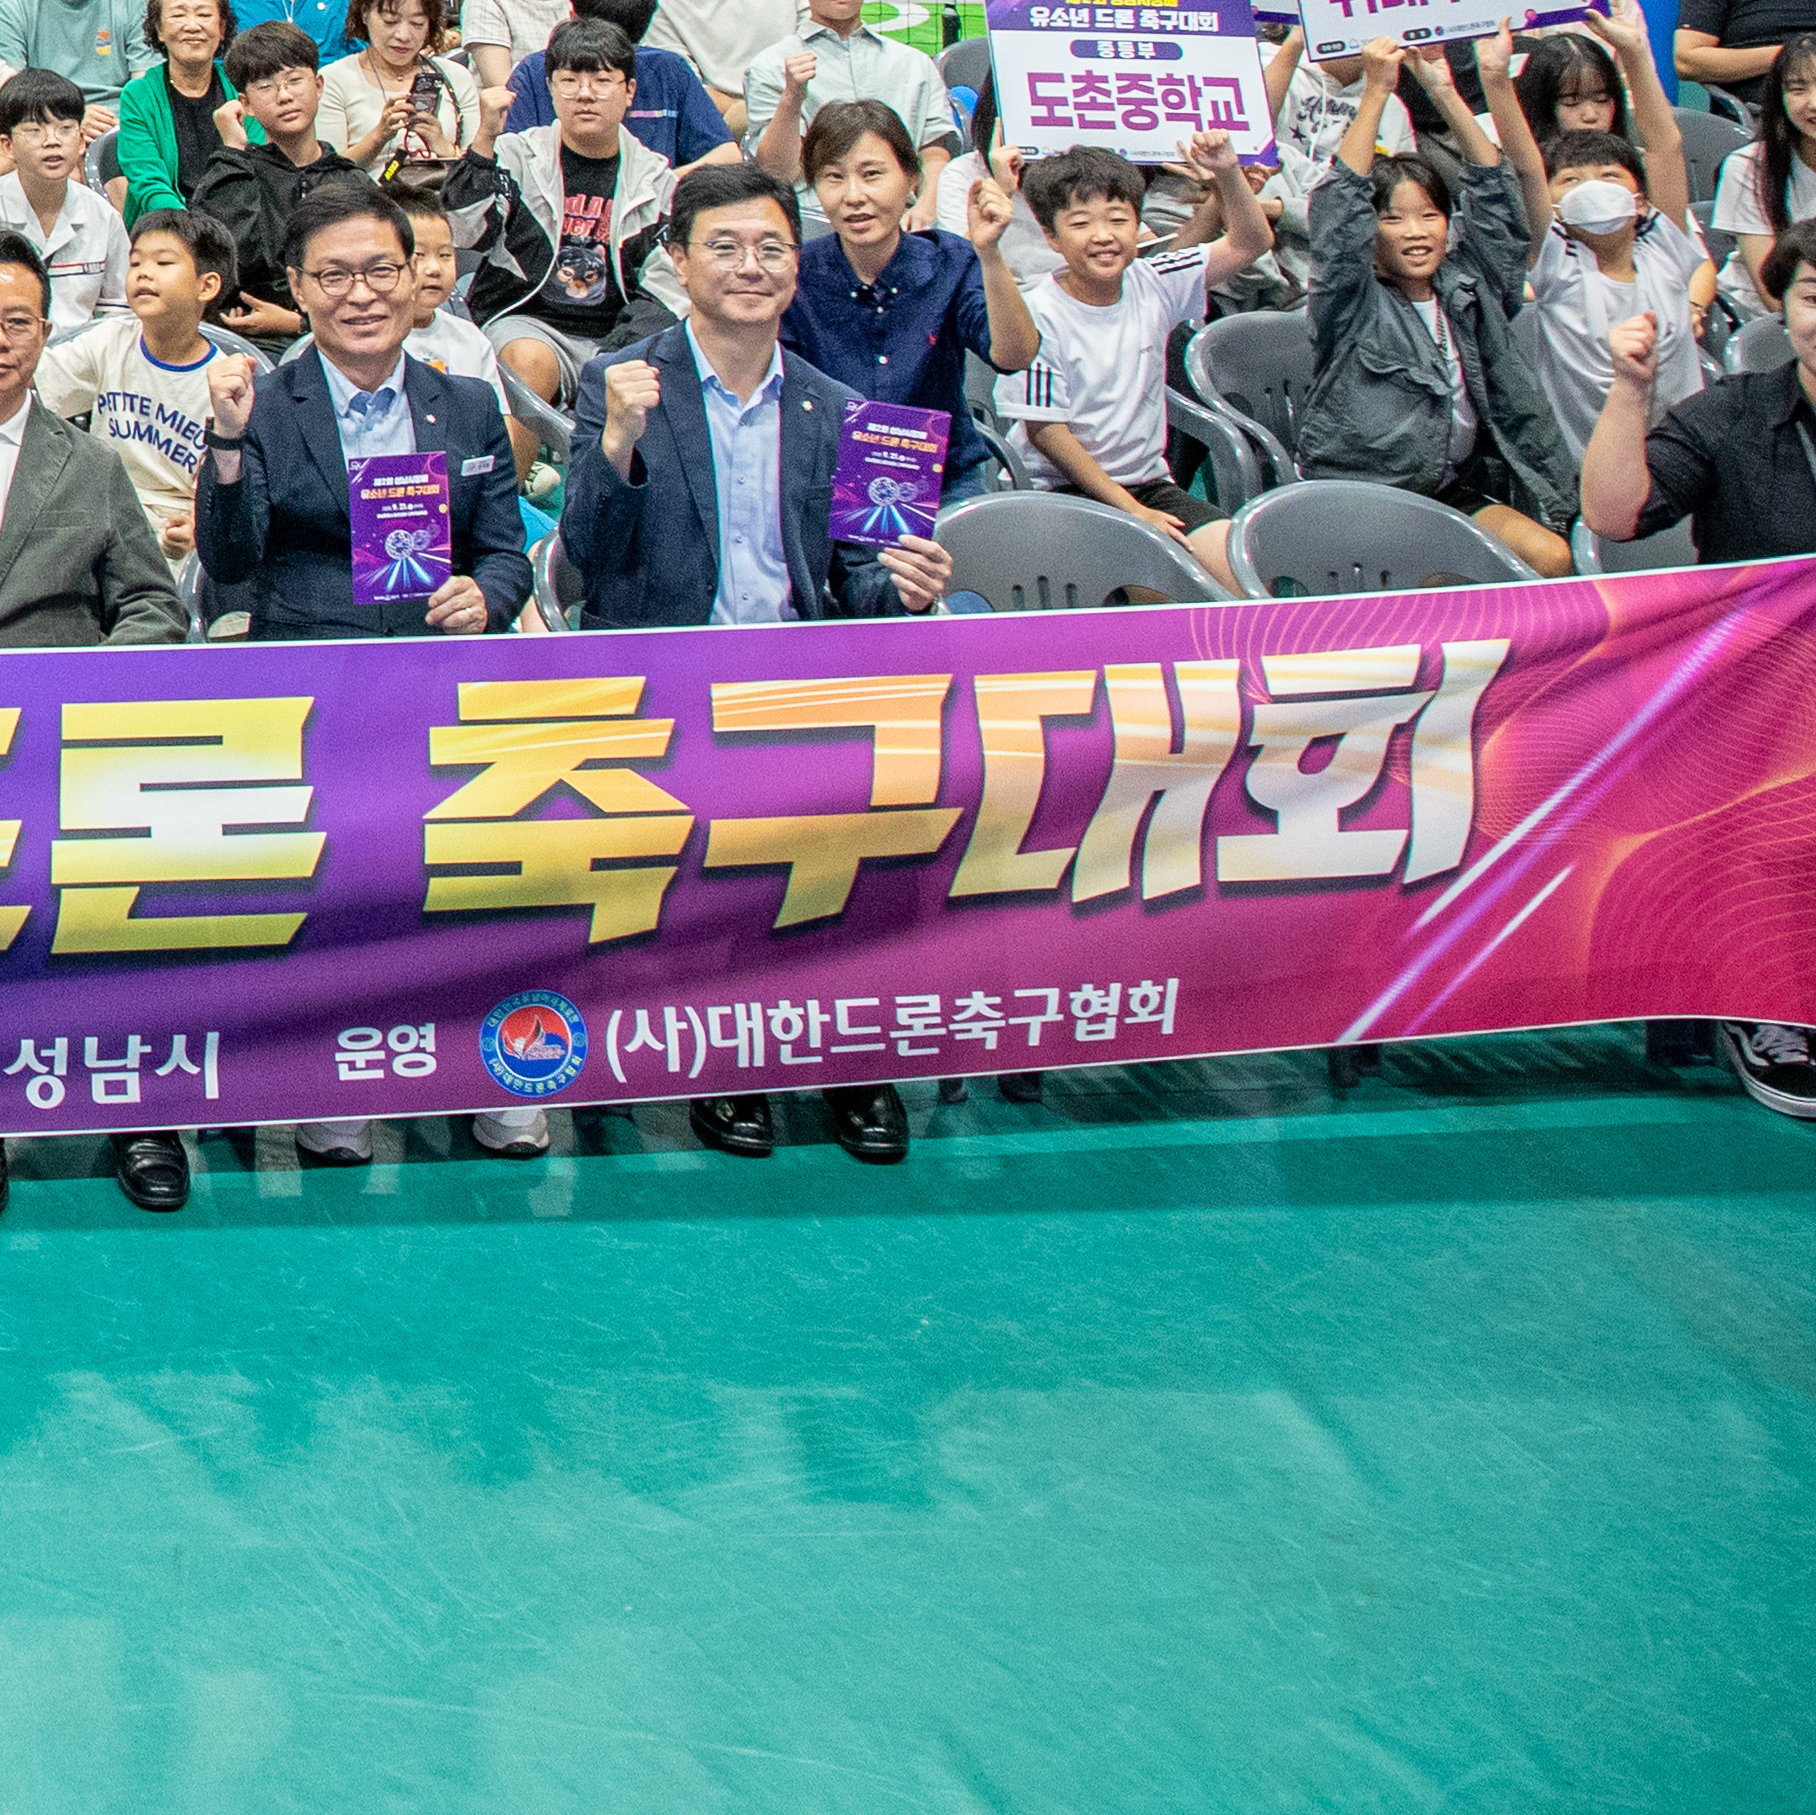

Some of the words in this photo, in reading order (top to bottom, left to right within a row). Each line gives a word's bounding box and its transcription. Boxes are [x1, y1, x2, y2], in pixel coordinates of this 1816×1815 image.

[1030, 6, 1090, 28] 유소년
[1095, 8, 1135, 28] 드론
[1139, 10, 1219, 32] 축구대회
[1097, 41, 1156, 59] 중등부
[1027, 70, 1251, 132] 도촌중학교
[109, 418, 197, 474] SUMMER
[421, 637, 1514, 946] 축구대회
[1, 1034, 221, 1106] 성남시
[332, 1021, 437, 1081] 운영
[605, 977, 1181, 1086] (사)대한드론축구협회
